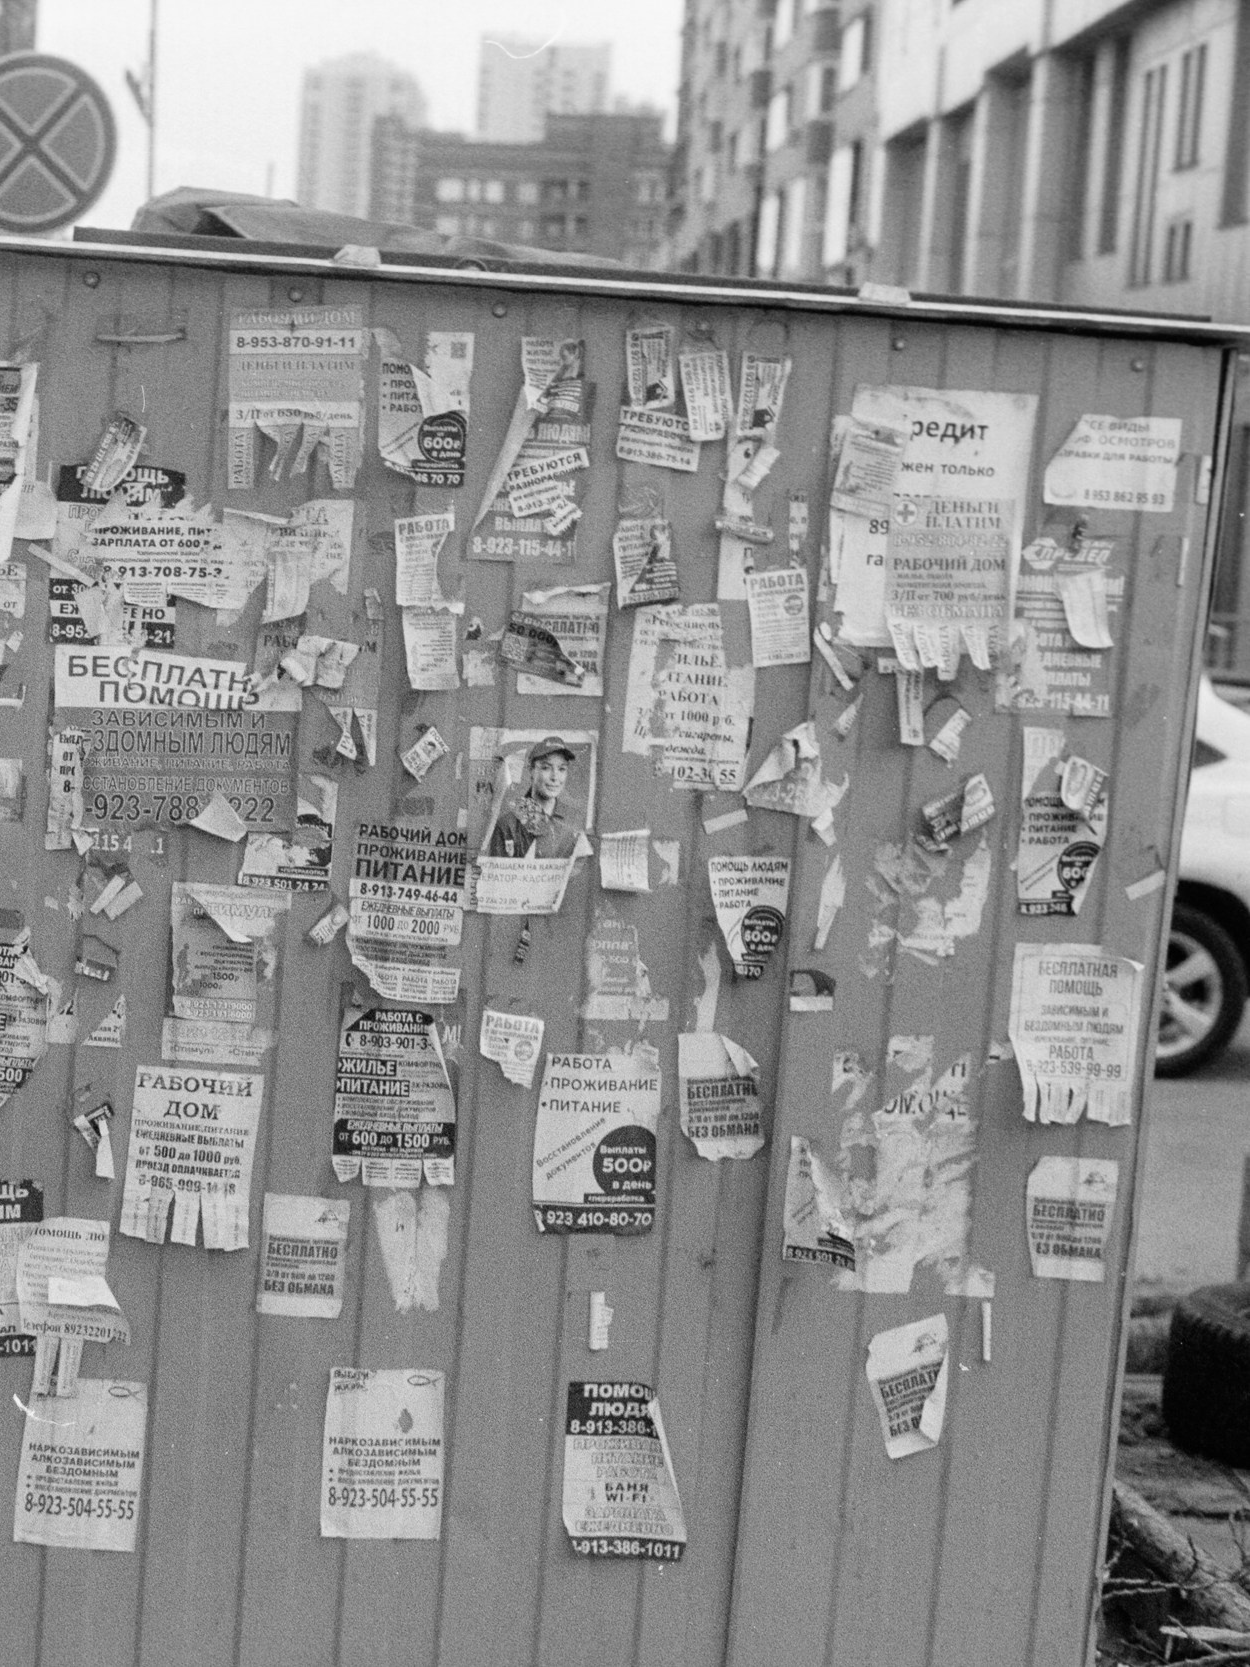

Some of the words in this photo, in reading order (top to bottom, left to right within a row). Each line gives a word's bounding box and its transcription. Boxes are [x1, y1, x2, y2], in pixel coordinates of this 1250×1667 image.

[236, 336, 356, 349] 8-953-870-91-11
[940, 464, 995, 478] только
[399, 518, 450, 535] РАБОТА
[92, 537, 156, 548] ЗАРПЛАТА
[159, 539, 175, 548] ОТ
[178, 539, 201, 549] 600
[893, 557, 967, 571] РАБОЧИЙ
[970, 558, 1006, 572] ДОМ
[751, 573, 804, 591] РАБОТА
[92, 711, 243, 728] ЗАВИСИМЫМ
[252, 714, 266, 728] И
[681, 710, 709, 723] 1000
[211, 733, 291, 756] ЛЮДЯМ
[197, 778, 289, 793] ДОКУМЕНТОВ
[359, 823, 431, 843] РАБОЧИЙ
[1028, 836, 1070, 845] РАБОТА
[357, 843, 468, 866] ПРОЖИВАНИЕ
[355, 858, 466, 887] ПИТАНИЕ
[710, 861, 749, 873] ПОМОЩЬ
[751, 861, 788, 873] ЛЮДЯМ
[719, 888, 759, 898] ПИТАНИЕ
[367, 914, 395, 931] 1000
[411, 919, 440, 935] 2000
[1038, 960, 1119, 978] БЕСПЛАТНАЯ
[1050, 979, 1104, 997] ПОМОЩЬ
[375, 1011, 415, 1023] РАБОТА
[1050, 1045, 1095, 1061] РАБОТА
[340, 1058, 396, 1076] ЖИЛЬЕ
[551, 1057, 612, 1070] РАБОТА
[137, 1072, 254, 1098] РАБОЧИЙ
[340, 1079, 409, 1096] ПИТАНИЕ
[550, 1077, 658, 1092] ПРОЖИВАНИЕ
[163, 1100, 221, 1121] ДОМ
[549, 1099, 621, 1113] ПИТАНИЕ
[352, 1131, 378, 1146] 600
[396, 1134, 430, 1148] 1500
[535, 1117, 606, 1168] Восстановление
[154, 1145, 176, 1159] 500
[193, 1150, 221, 1164] 1000
[599, 1146, 647, 1155] Выплаты
[622, 1180, 652, 1190] день
[546, 1210, 573, 1224] 923
[577, 1212, 652, 1227] 410-80-70
[267, 1242, 338, 1260] БЕСПЛАТНО
[263, 1280, 285, 1293] БЕЗ
[287, 1281, 335, 1296] ОБМАНА
[328, 1436, 442, 1448] НАРКОЗАВИСИМЫМ
[29, 1442, 140, 1460] НАРКОЗАВИСИМЫМ
[31, 1453, 136, 1470] АЛКОЗАВИСИМЫМ
[347, 1457, 422, 1468] БЕЗДОМНЫМ
[45, 1464, 119, 1479] БЕЗДОМНЫМ
[605, 1482, 649, 1493] БАНЯ
[24, 1492, 135, 1520] 8-923-504-55-55
[328, 1487, 439, 1508] 8-923-504-55-55
[605, 1493, 647, 1503] WI-FI
